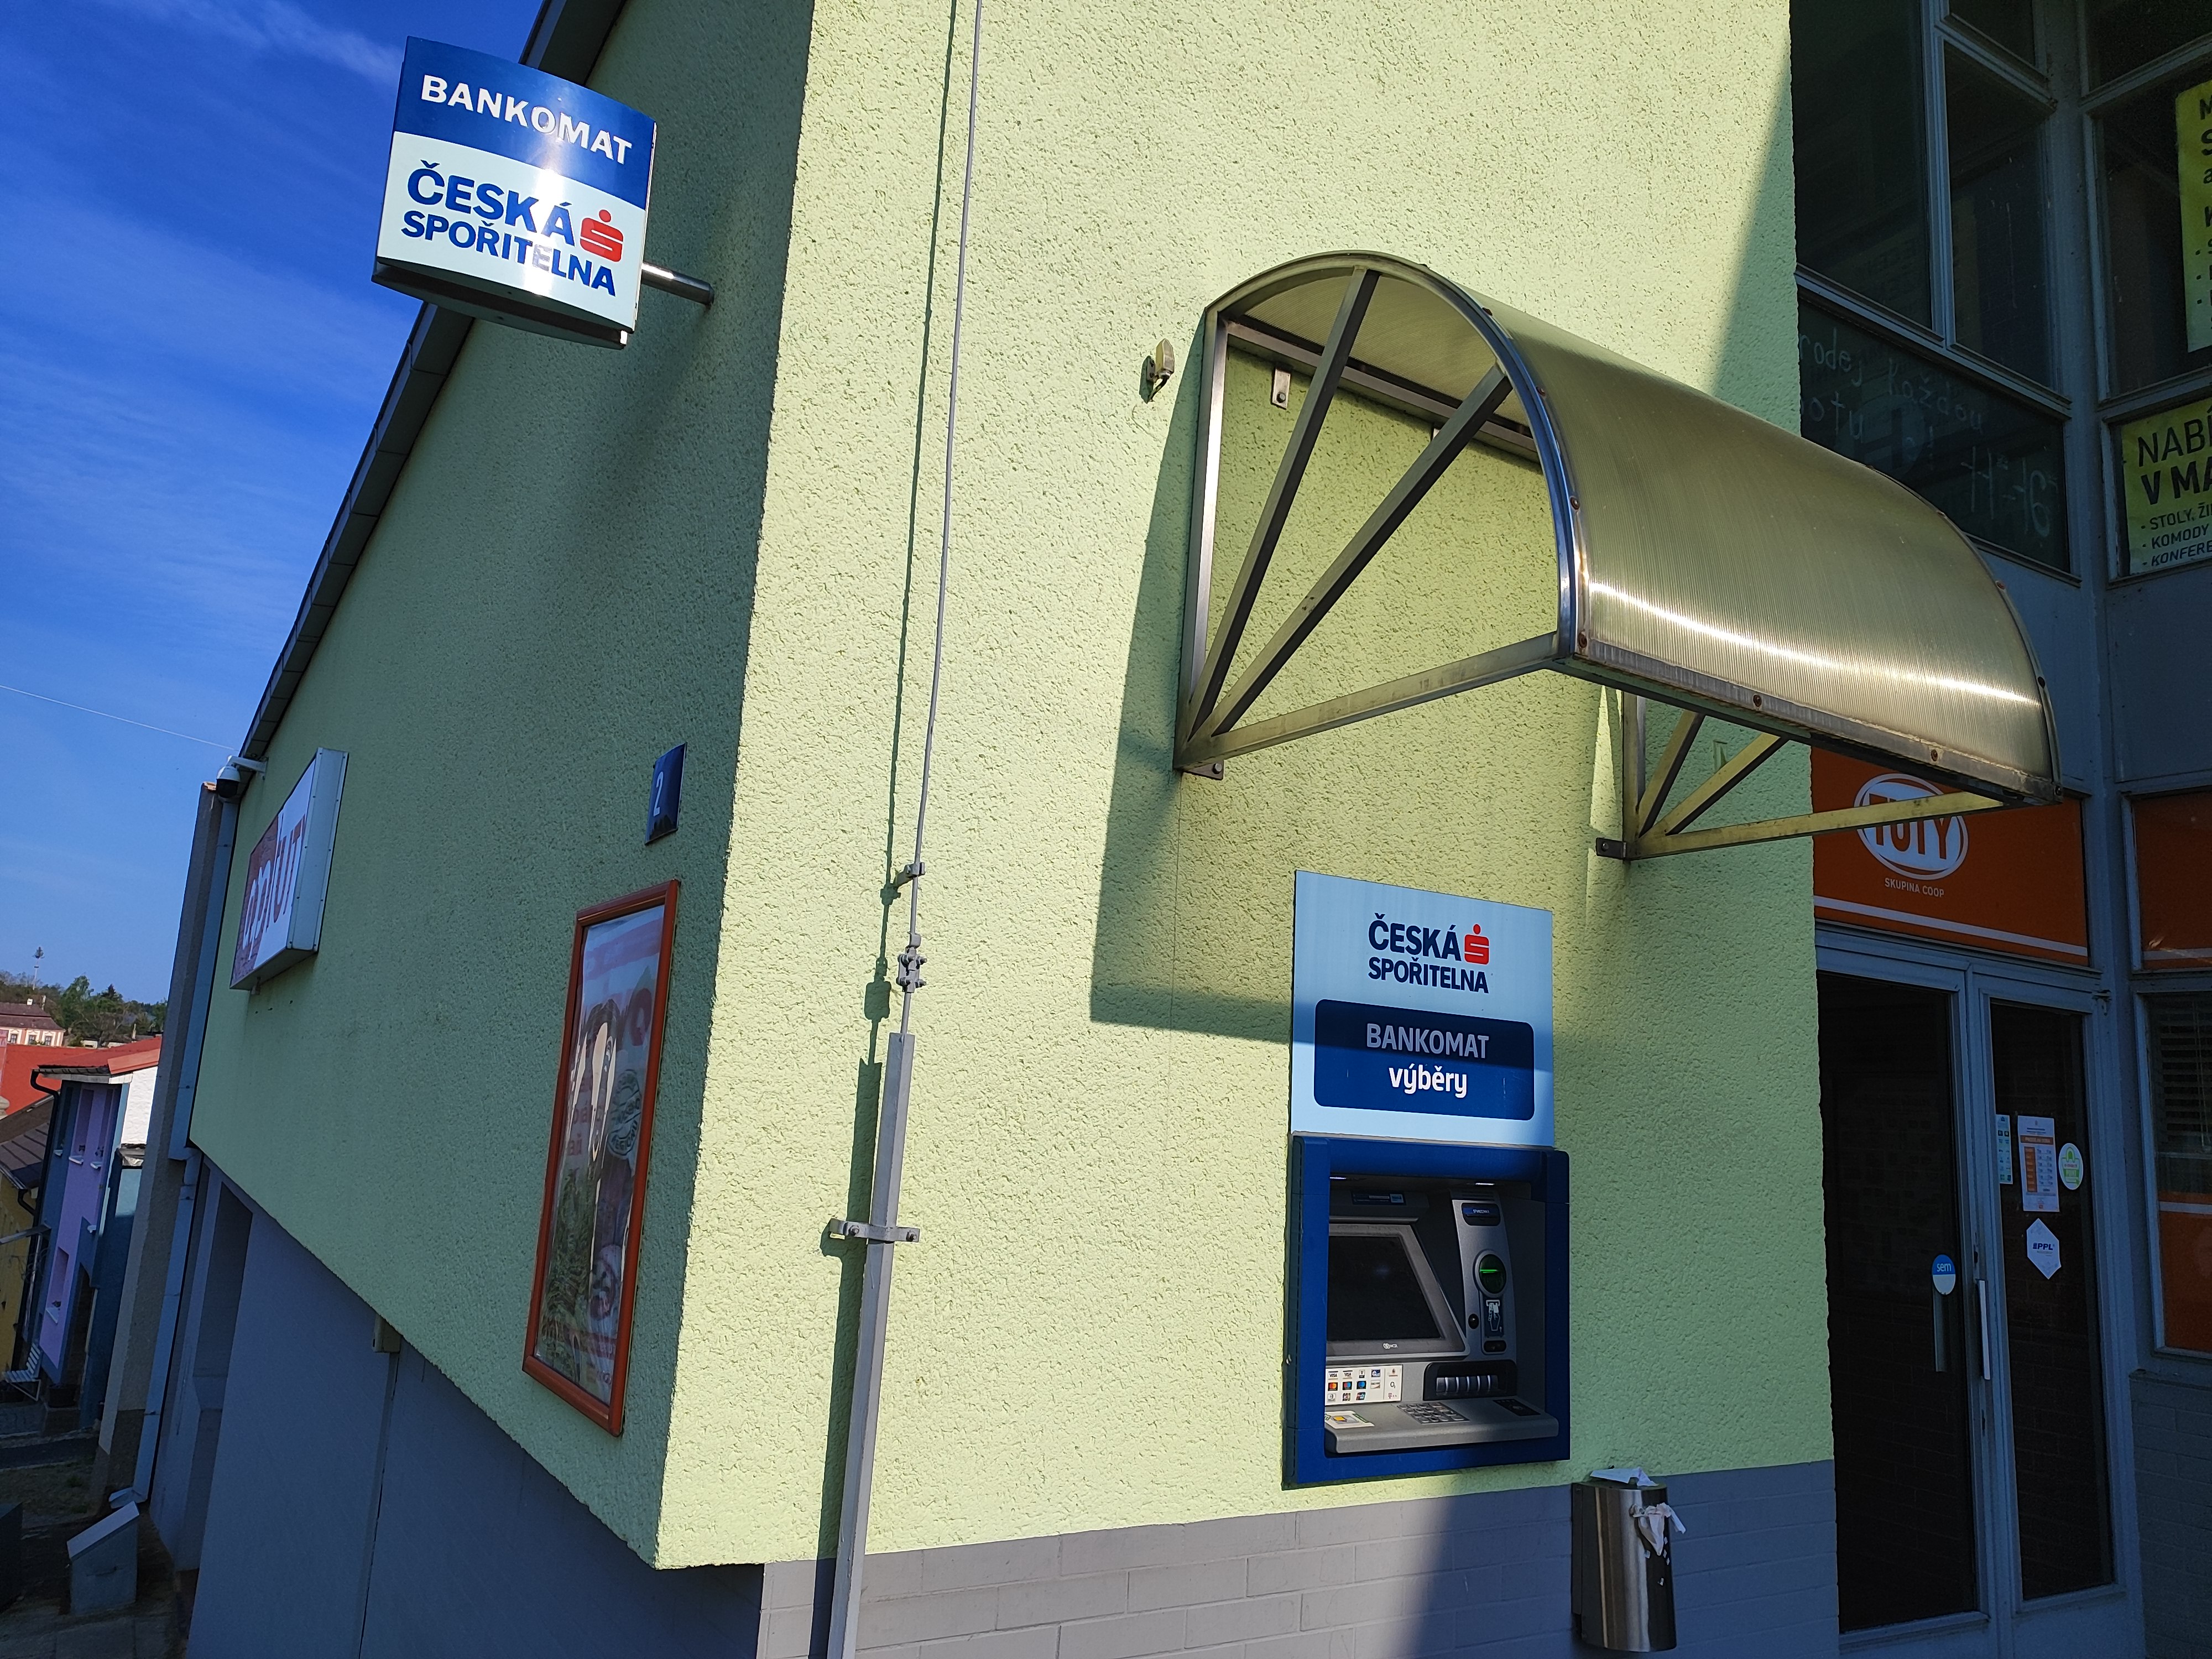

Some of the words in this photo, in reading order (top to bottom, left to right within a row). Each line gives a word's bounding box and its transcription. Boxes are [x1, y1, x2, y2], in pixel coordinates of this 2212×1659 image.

[421, 75, 632, 165] BANKOMAT
[408, 159, 575, 248] ČESKÁ
[401, 210, 616, 297] SPOŘITELNA
[2141, 470, 2161, 505] V
[2150, 508, 2195, 530] STOLY,
[2152, 523, 2209, 549] KOMODY
[653, 770, 664, 817] 2
[1885, 877, 1921, 894] SKUPINA
[1922, 885, 1944, 898] COOP
[1368, 912, 1462, 962] ČESKÁ
[1368, 957, 1489, 994] SPOŘITELNA
[1366, 1023, 1489, 1059] BANKOMAT
[1389, 1062, 1468, 1099] výběry
[2037, 1243, 2053, 1251] PPL
[1937, 1263, 1952, 1272] sem
